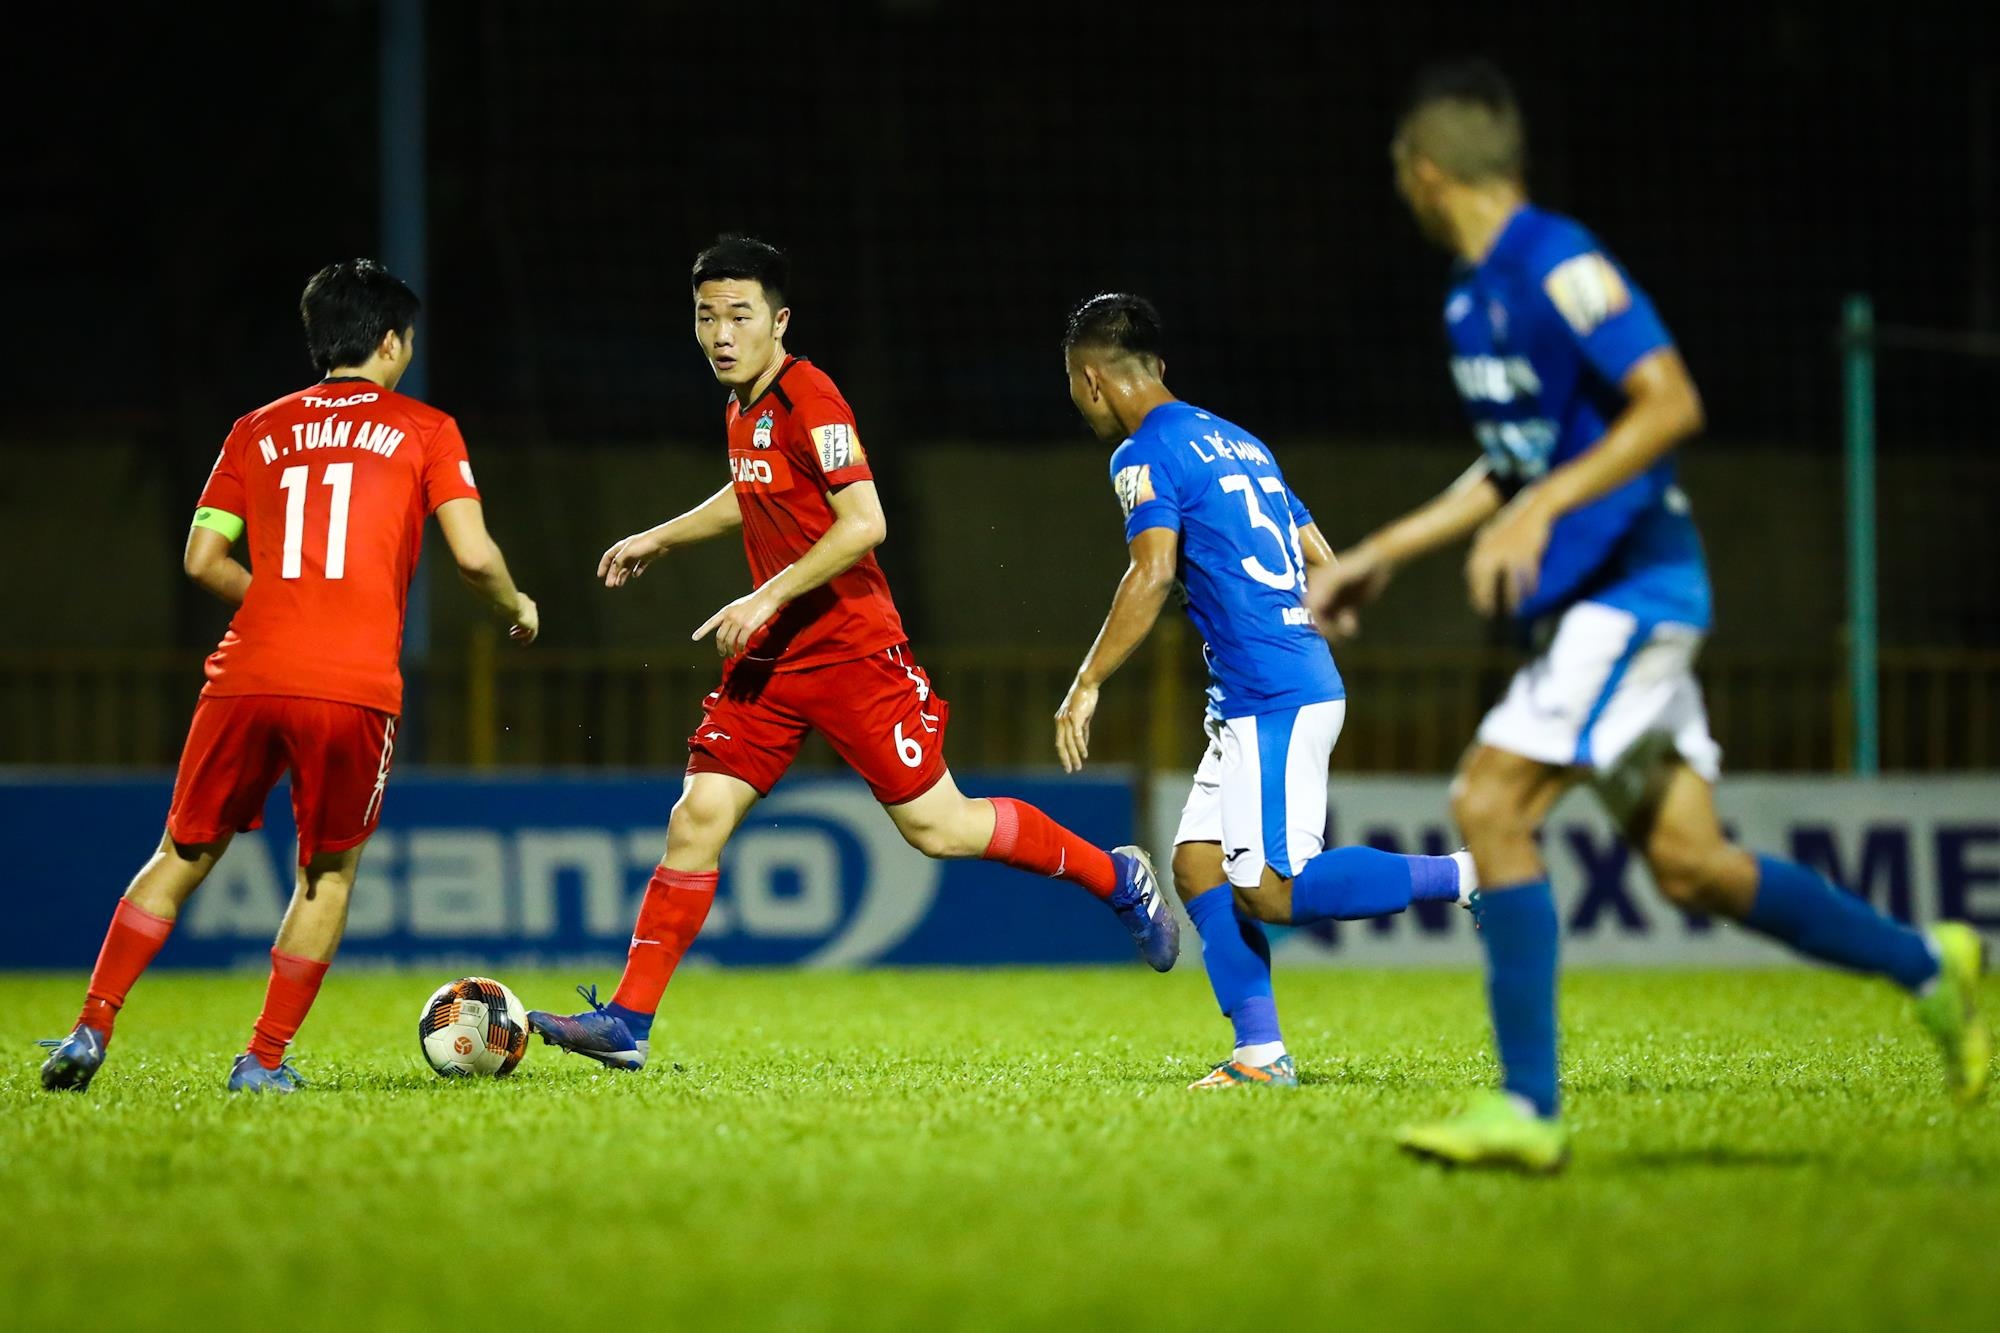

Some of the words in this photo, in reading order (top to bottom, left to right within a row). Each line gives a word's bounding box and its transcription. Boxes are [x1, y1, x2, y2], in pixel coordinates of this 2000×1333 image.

[301, 392, 379, 408] THACO
[292, 413, 352, 452] TUẤN
[352, 420, 405, 458] ANH
[729, 457, 773, 484] HACO
[279, 462, 354, 580] 11
[894, 721, 923, 768] 6
